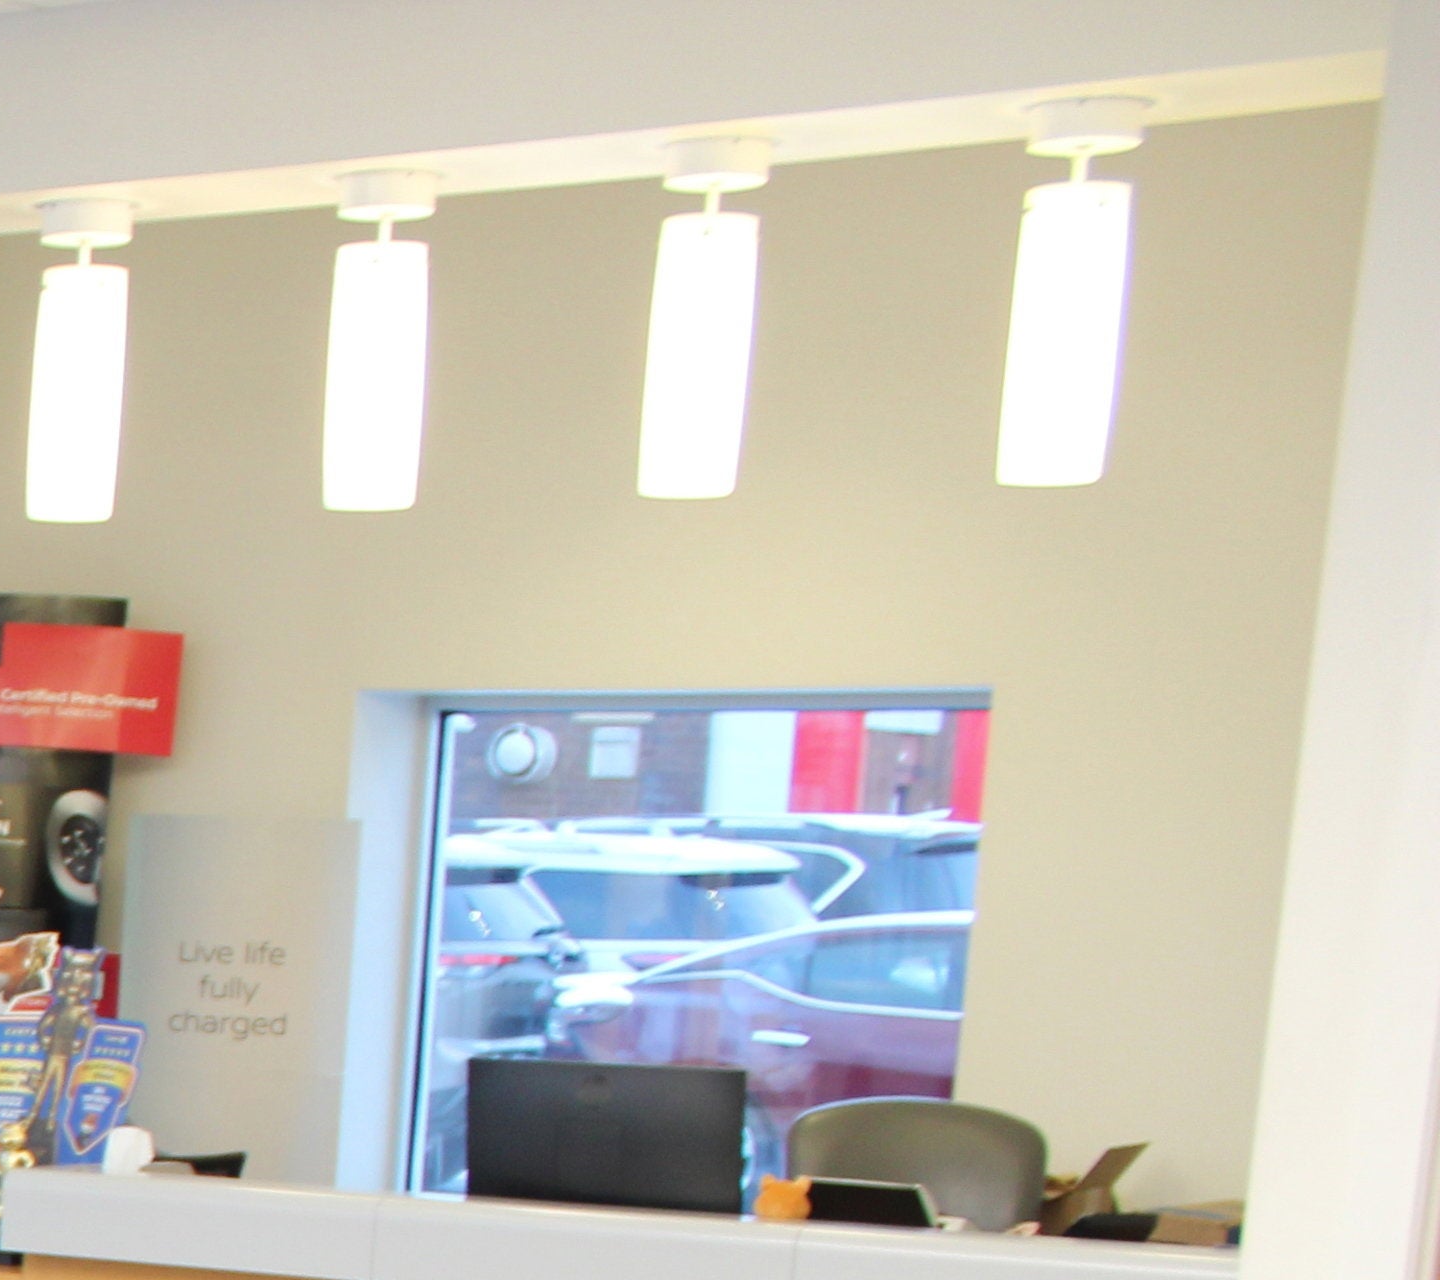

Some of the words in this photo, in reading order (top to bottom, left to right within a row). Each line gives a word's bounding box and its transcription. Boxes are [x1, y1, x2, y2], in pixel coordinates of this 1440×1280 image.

[179, 941, 233, 964] Live
[244, 941, 286, 966] life
[200, 974, 261, 1006] fully
[168, 1012, 288, 1041] charged
